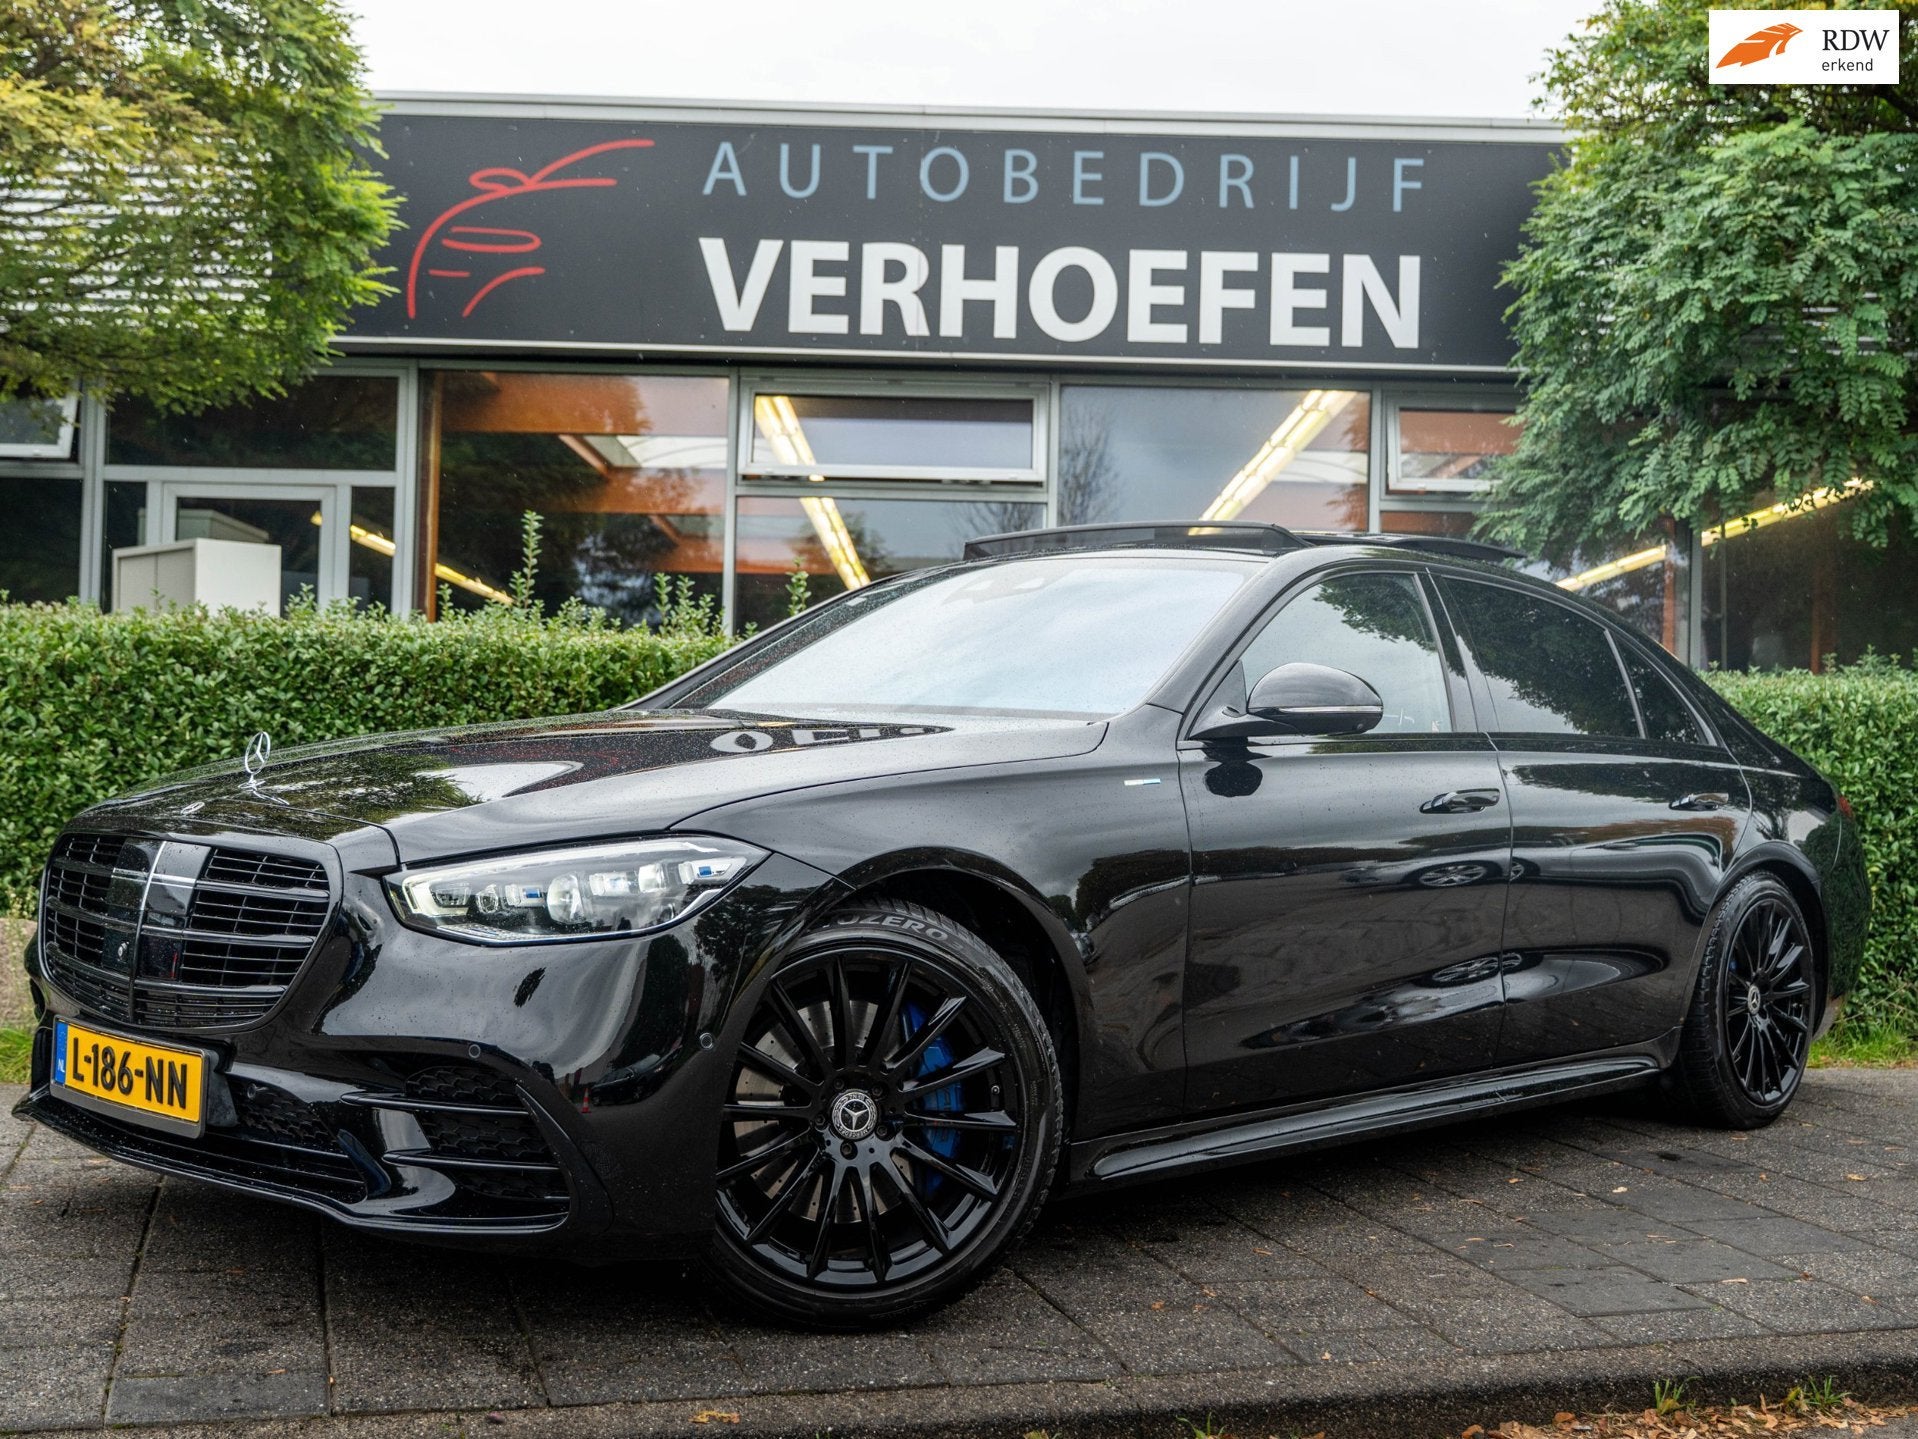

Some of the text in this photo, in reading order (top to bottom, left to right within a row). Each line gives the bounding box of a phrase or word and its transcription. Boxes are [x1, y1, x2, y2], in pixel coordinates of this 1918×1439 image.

[703, 141, 1425, 213] AUTOBEDRIJF
[698, 237, 1421, 350] VERHOEFEN
[57, 1058, 66, 1074] NL
[72, 1037, 188, 1110] L-186-NN
